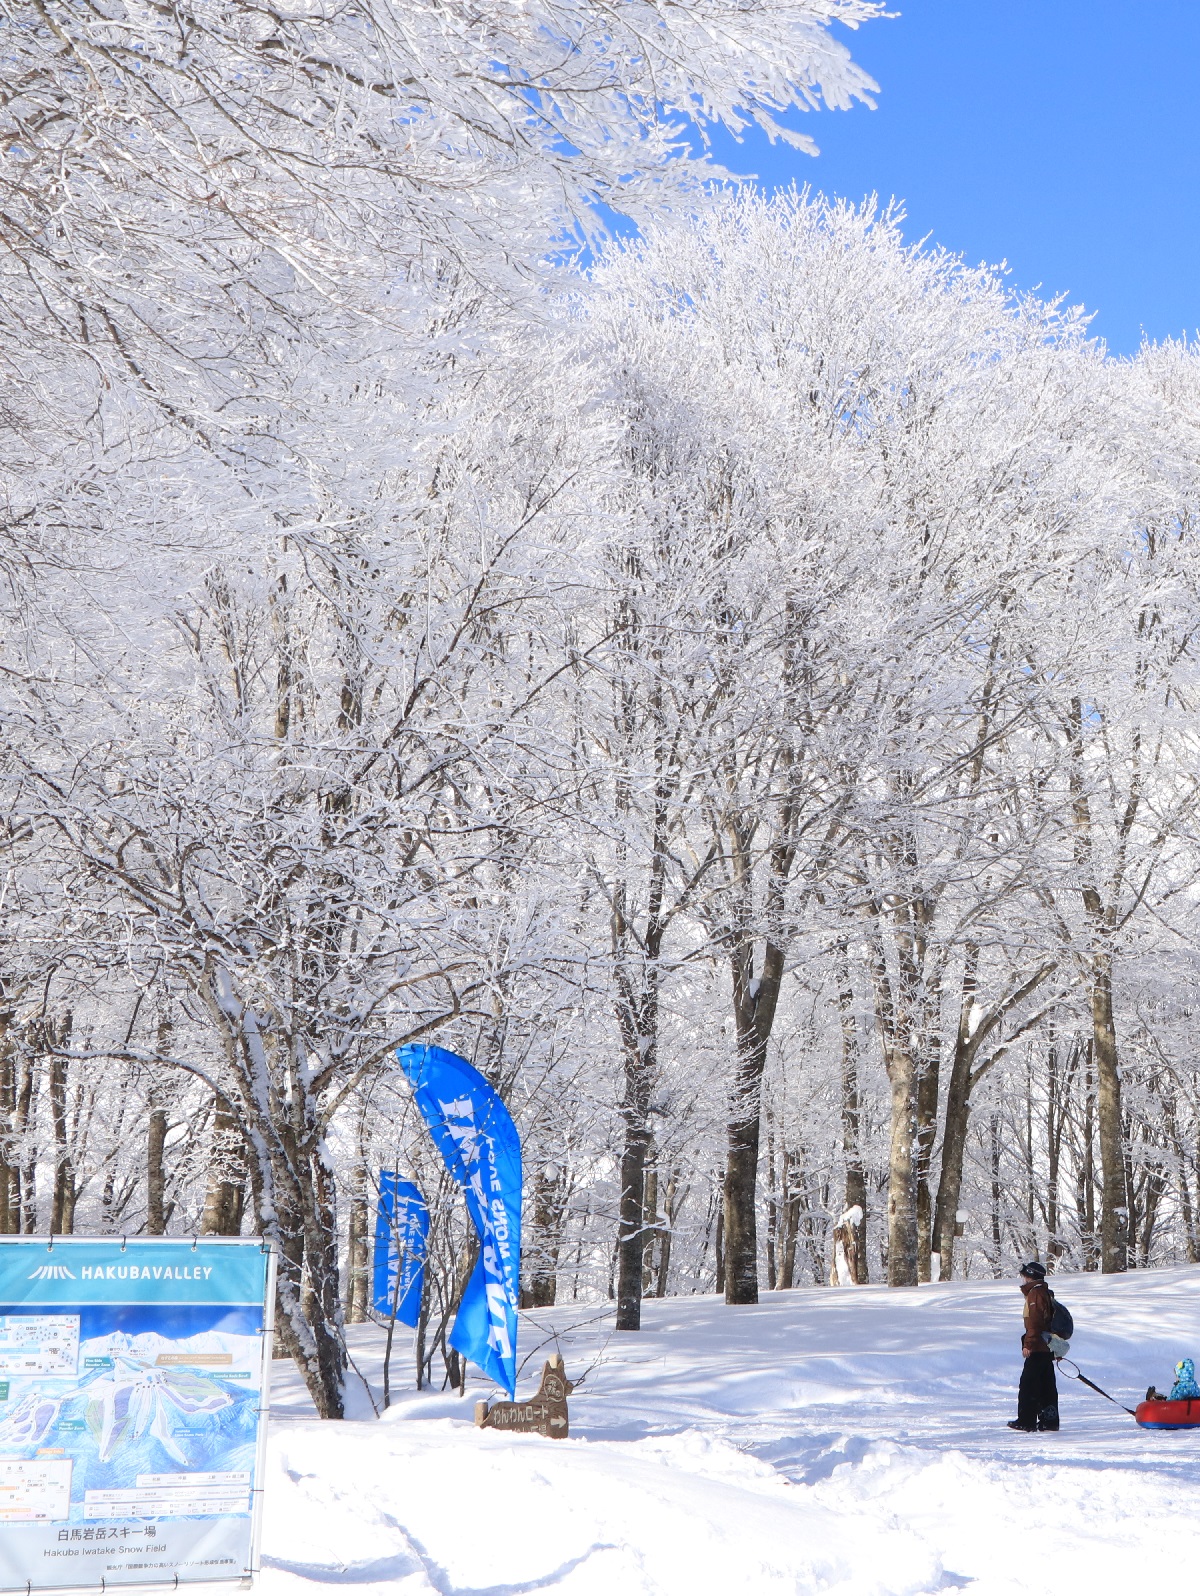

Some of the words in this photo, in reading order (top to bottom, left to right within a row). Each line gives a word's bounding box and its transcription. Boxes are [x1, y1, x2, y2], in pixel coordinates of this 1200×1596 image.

[81, 1265, 213, 1280] HAKUBAVALLEY
[57, 1525, 157, 1542] 白馬岩岳スキー場
[43, 1548, 80, 1557] Hakuba
[81, 1546, 116, 1556] Iwatake
[118, 1545, 143, 1554] Snow
[145, 1544, 167, 1552] Field
